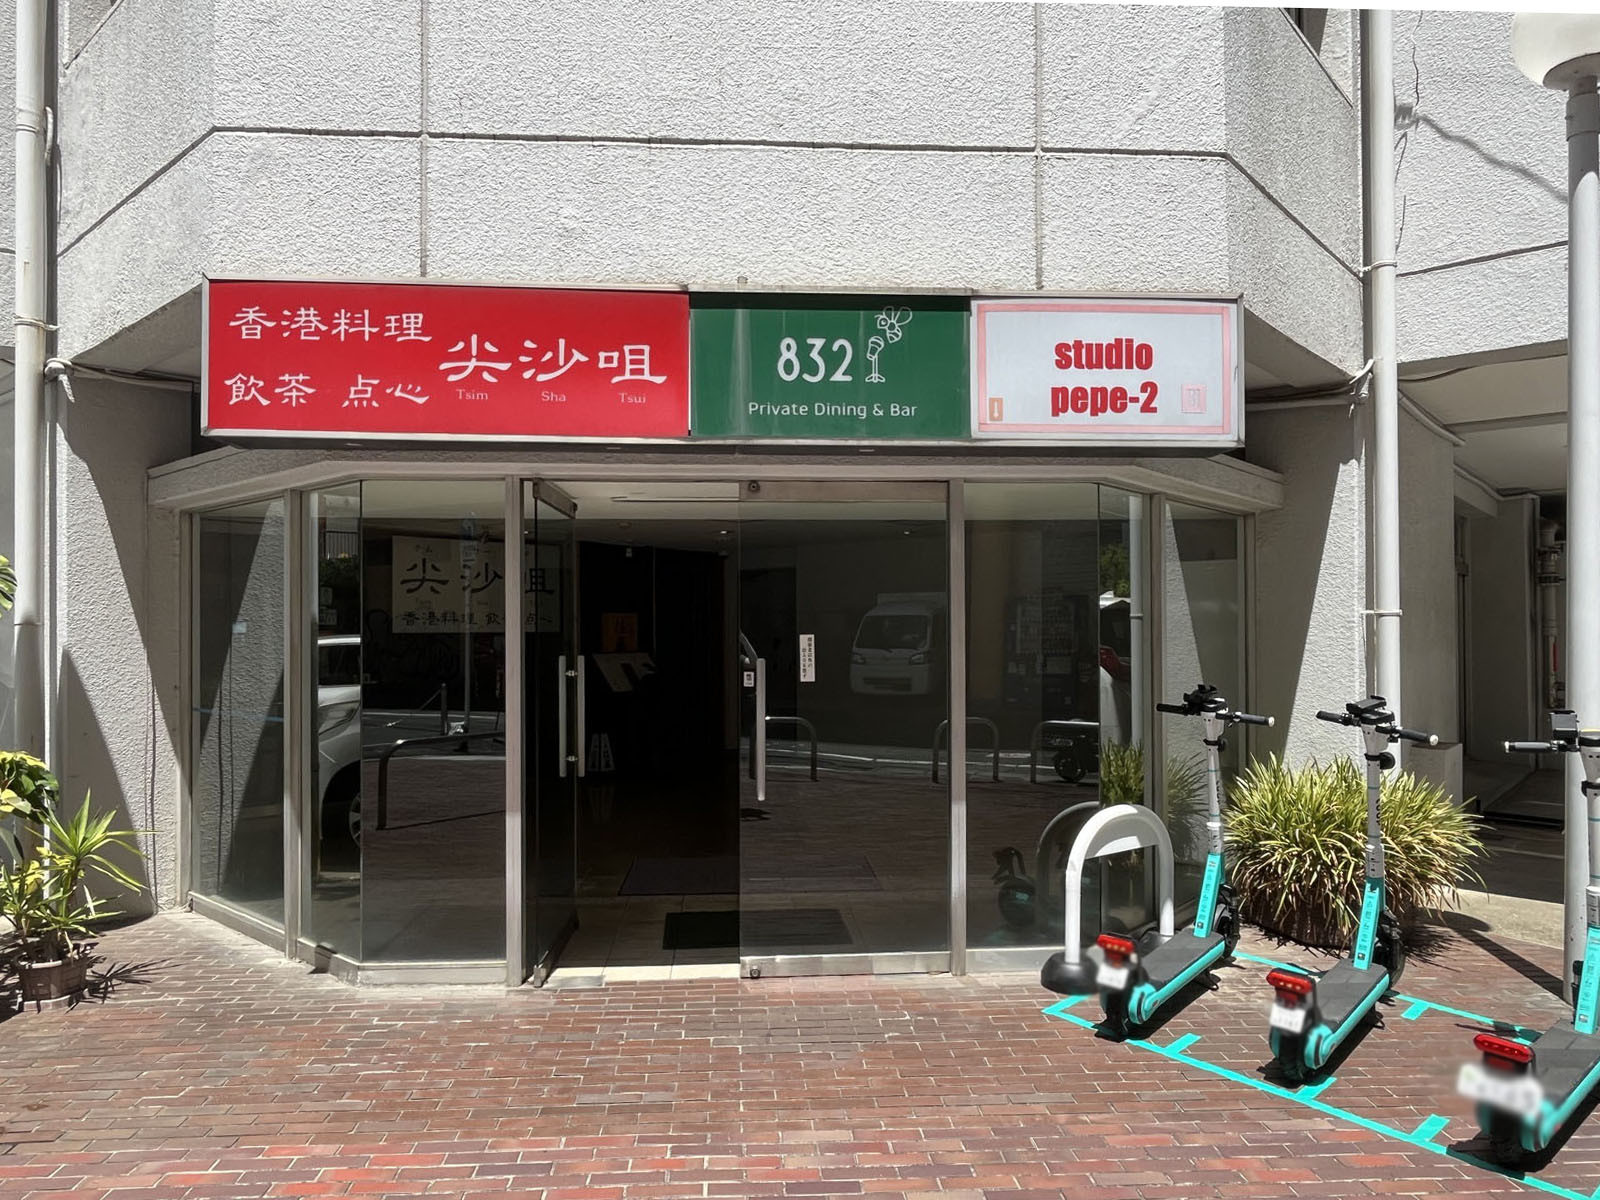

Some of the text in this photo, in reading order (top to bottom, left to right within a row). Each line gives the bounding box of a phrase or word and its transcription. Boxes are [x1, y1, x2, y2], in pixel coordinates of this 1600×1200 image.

[229, 306, 433, 342] 香港料理
[438, 333, 668, 385] 尖沙咀
[776, 337, 853, 383] 832
[1054, 338, 1153, 371] studio
[224, 373, 430, 408] 飲茶 点心
[455, 388, 647, 404] Tsim Sha Tsui
[1050, 381, 1158, 418] pepe-2
[748, 401, 918, 420] Private Dining & Bar
